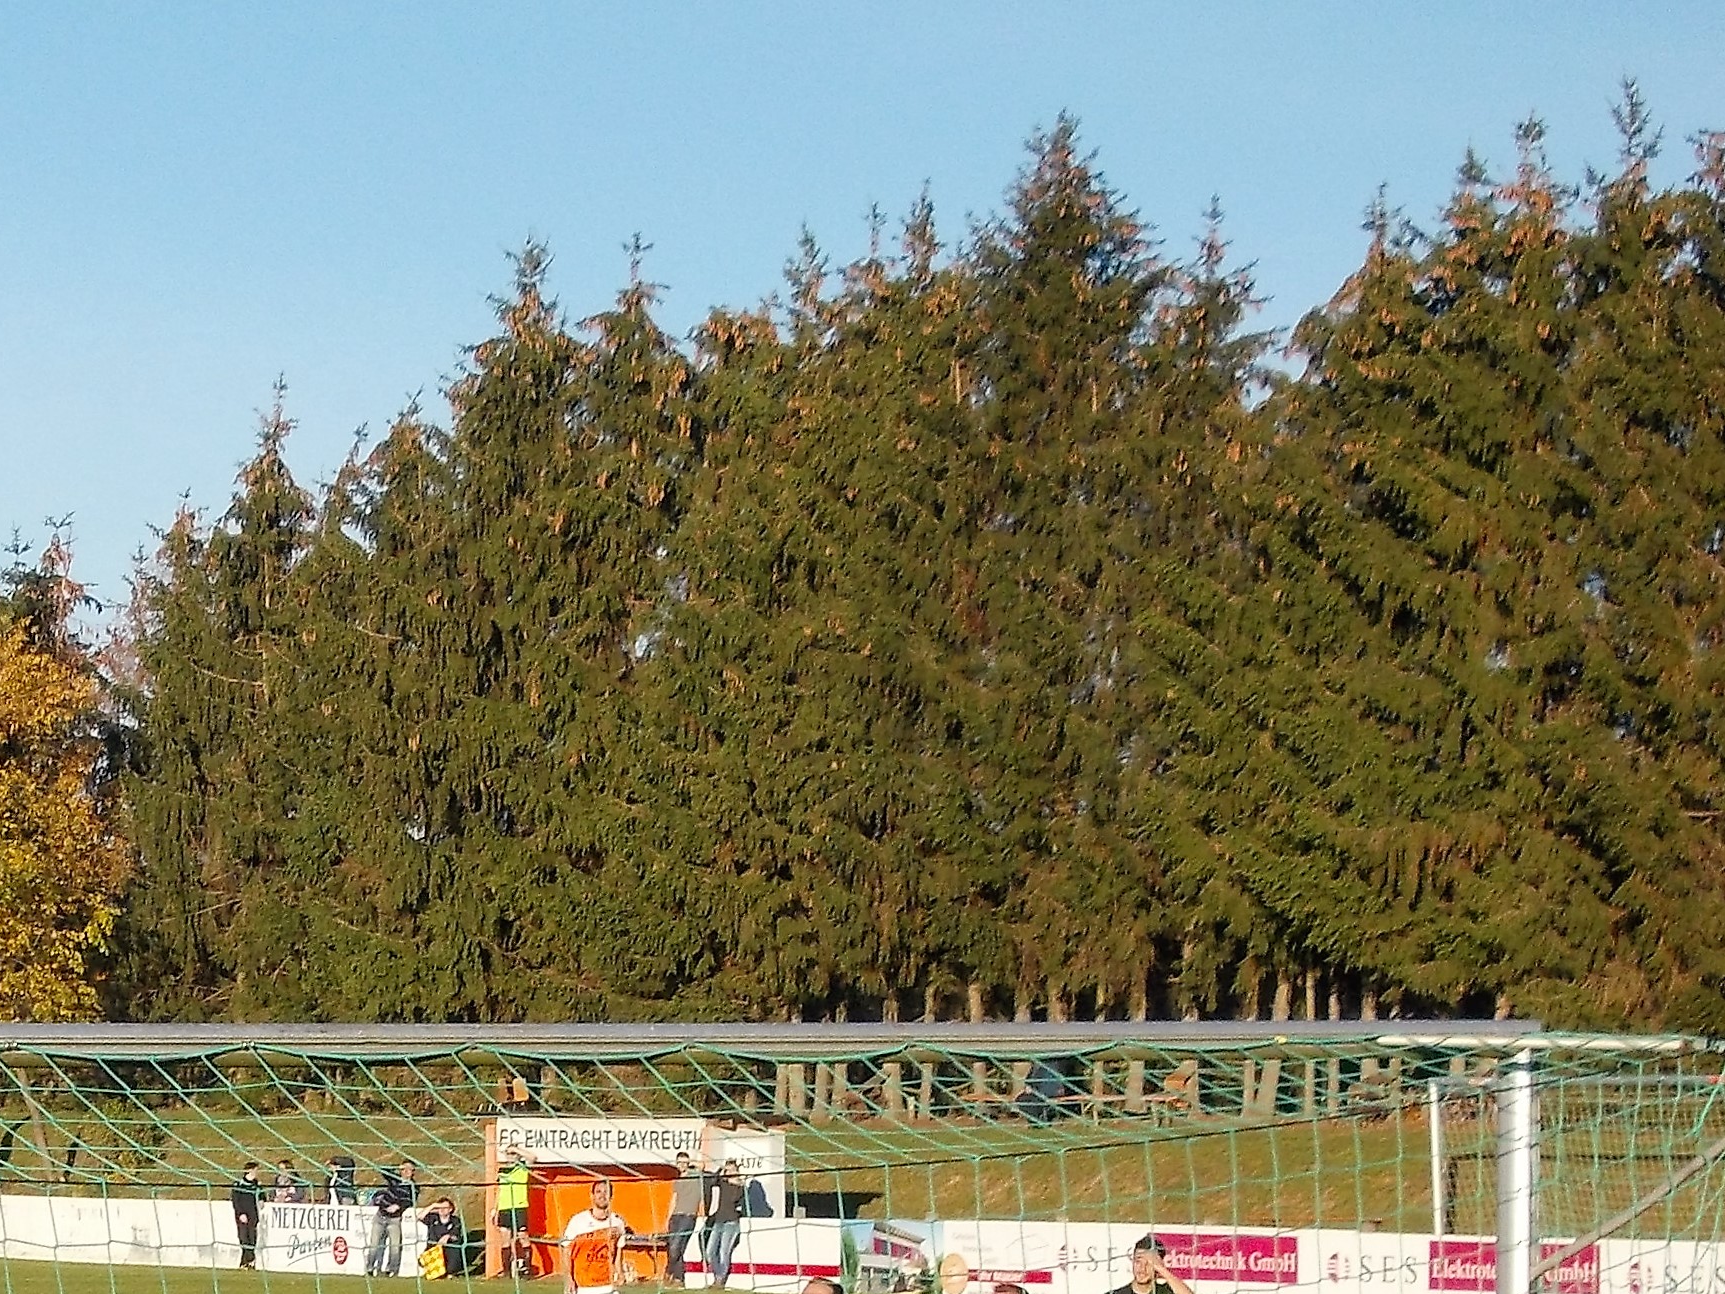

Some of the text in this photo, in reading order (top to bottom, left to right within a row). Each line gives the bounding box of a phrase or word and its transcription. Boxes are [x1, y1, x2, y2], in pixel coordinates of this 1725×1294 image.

[499, 1129, 704, 1151] FC EINTRACHT BAYREUTH
[271, 1207, 350, 1231] METZGEREI
[1249, 1251, 1296, 1273] GmbH
[1359, 1254, 1418, 1284] SES
